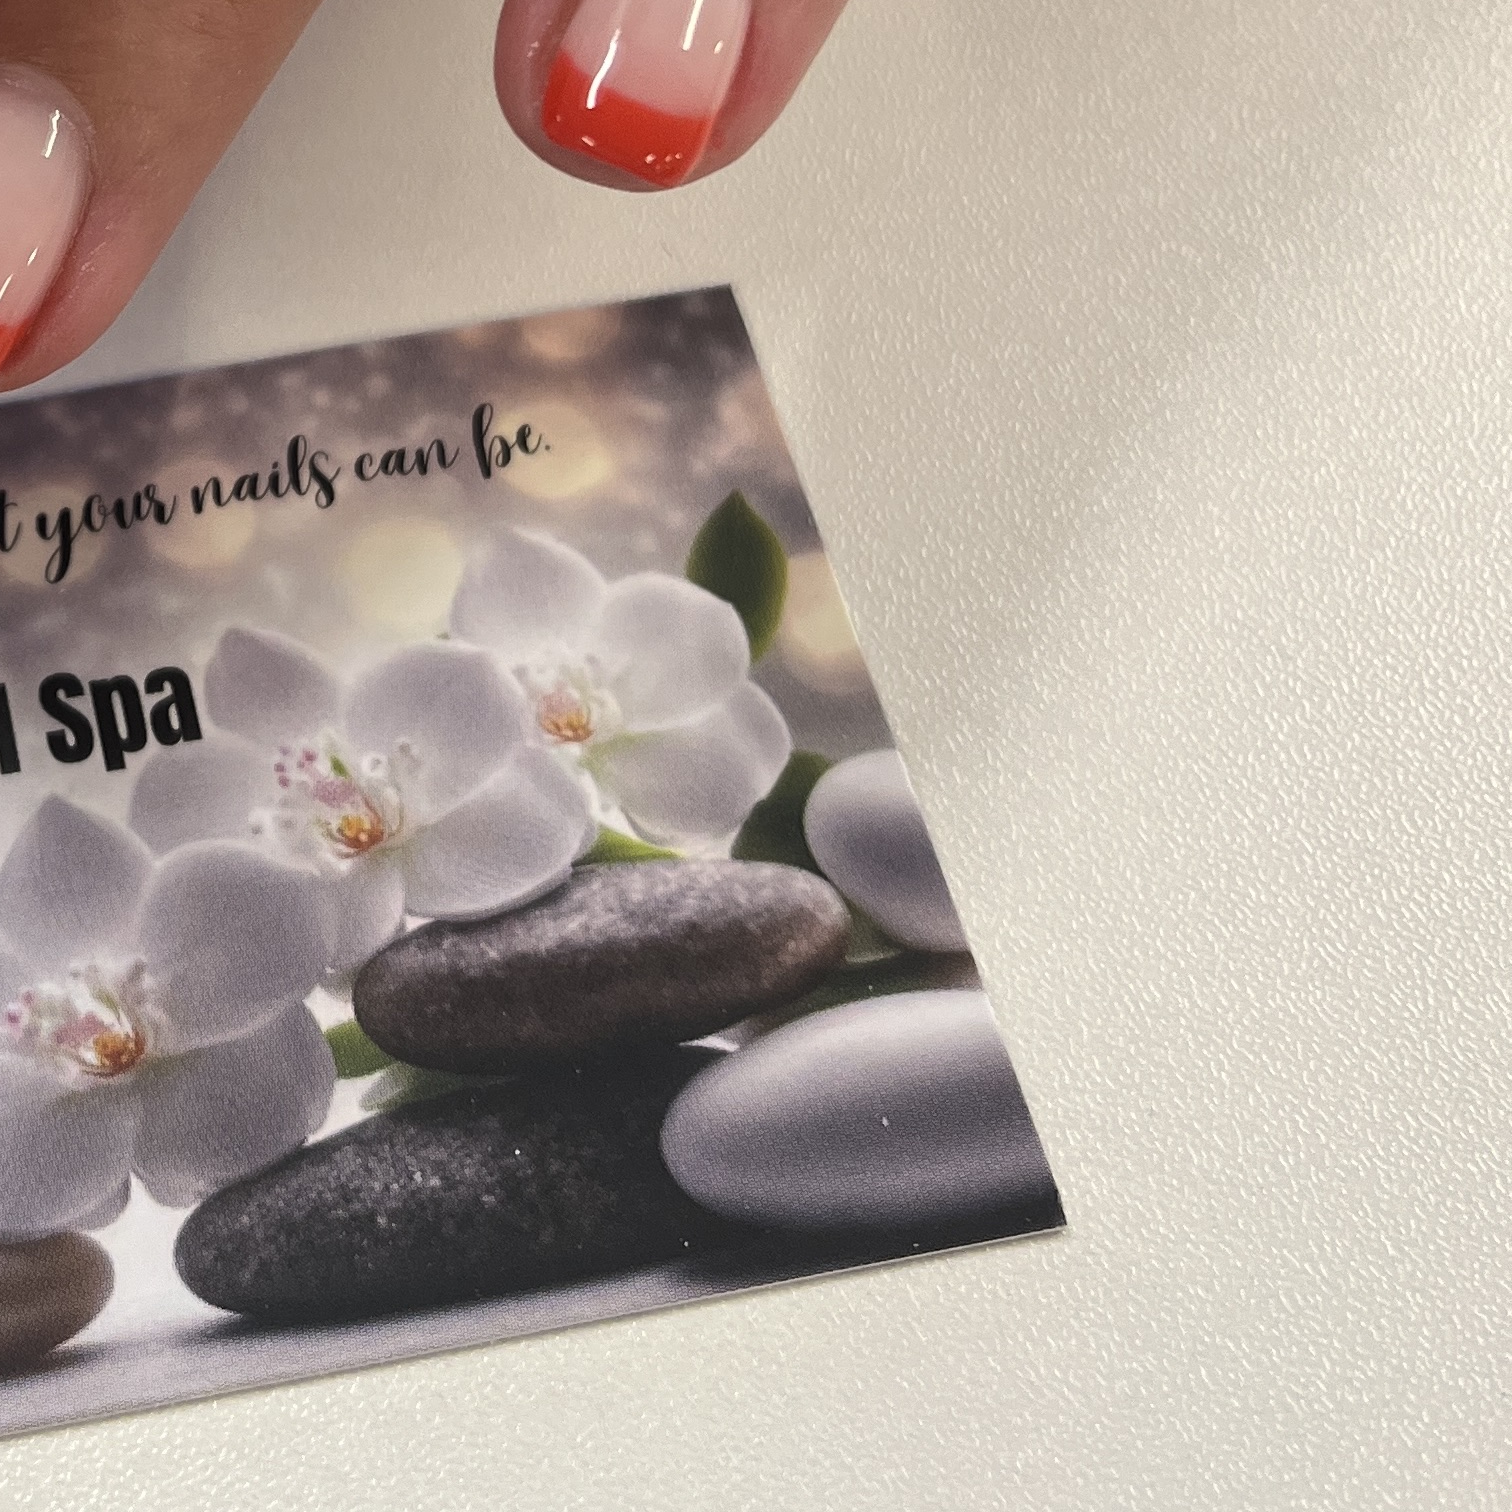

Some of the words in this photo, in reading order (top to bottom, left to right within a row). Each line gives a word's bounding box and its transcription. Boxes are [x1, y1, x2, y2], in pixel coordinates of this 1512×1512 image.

[35, 483, 176, 585] your
[191, 434, 340, 509] nails
[354, 435, 459, 482] can
[471, 402, 551, 481] be.
[38, 665, 203, 771] Spa
